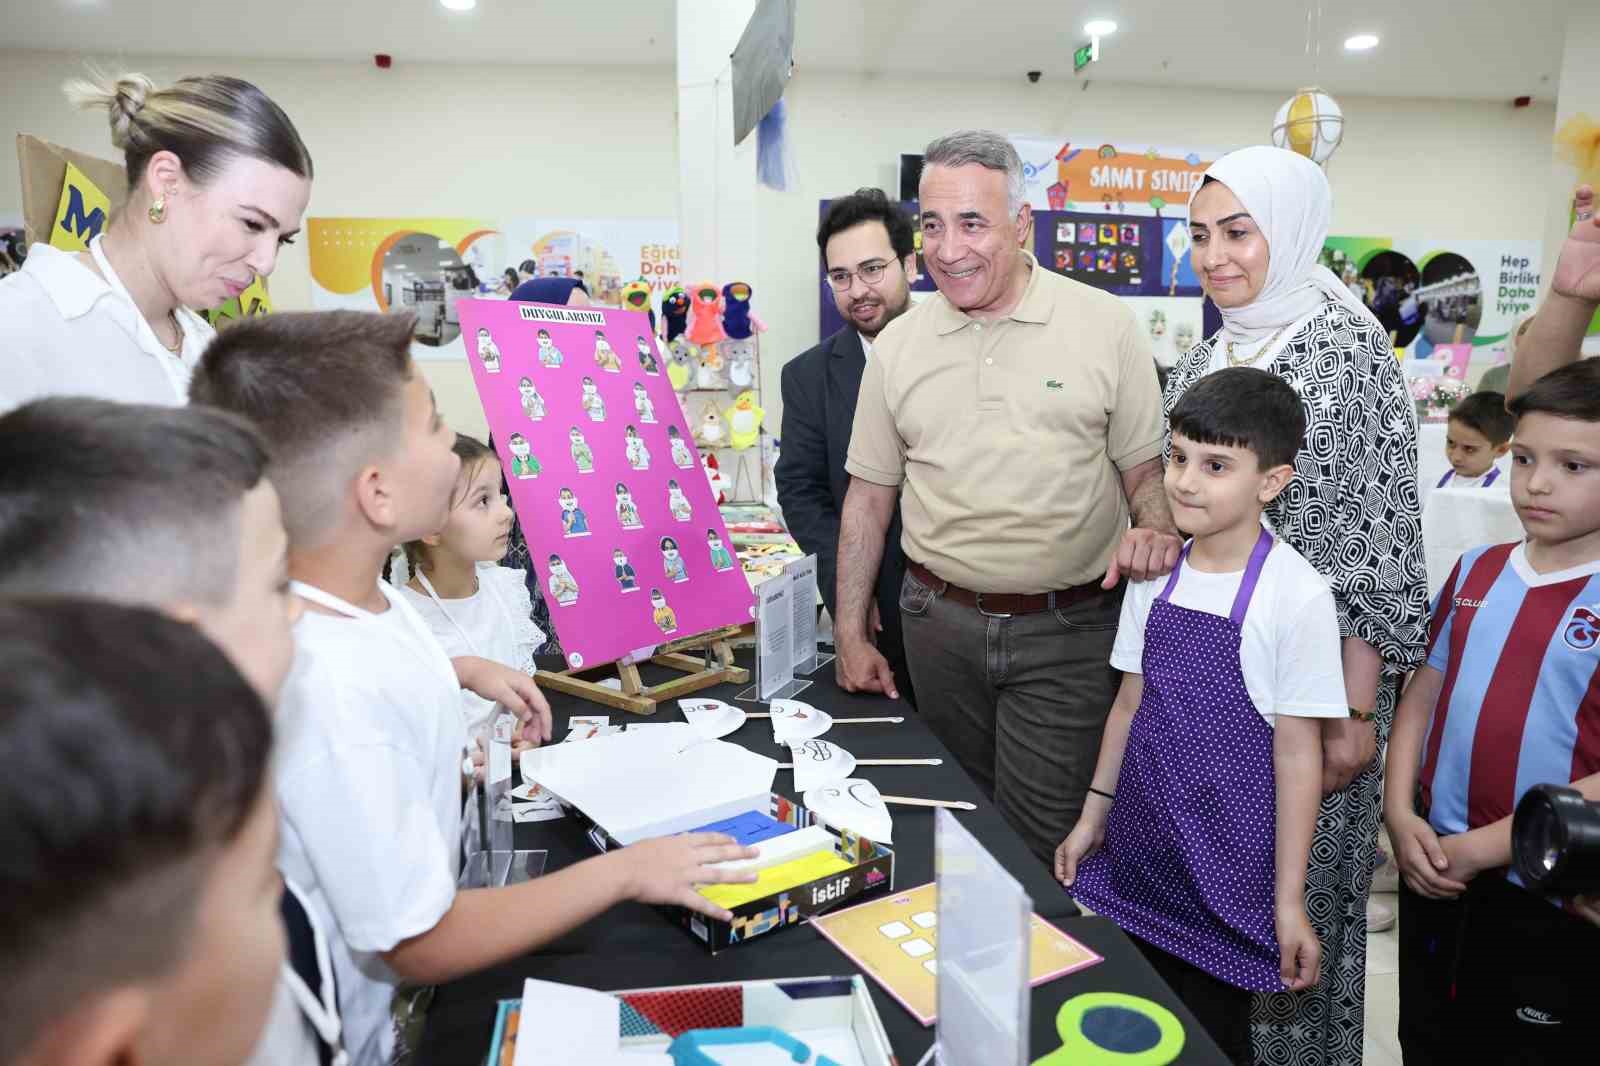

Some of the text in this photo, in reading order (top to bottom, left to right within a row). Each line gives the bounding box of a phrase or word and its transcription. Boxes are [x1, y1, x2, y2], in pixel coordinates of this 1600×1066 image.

[1089, 165, 1147, 191] SANAT
[60, 184, 107, 248] M
[1501, 255, 1529, 270] Hep
[1498, 286, 1536, 298] Daha
[1461, 598, 1488, 609] CLUB
[1523, 1007, 1552, 1021] NIKE
